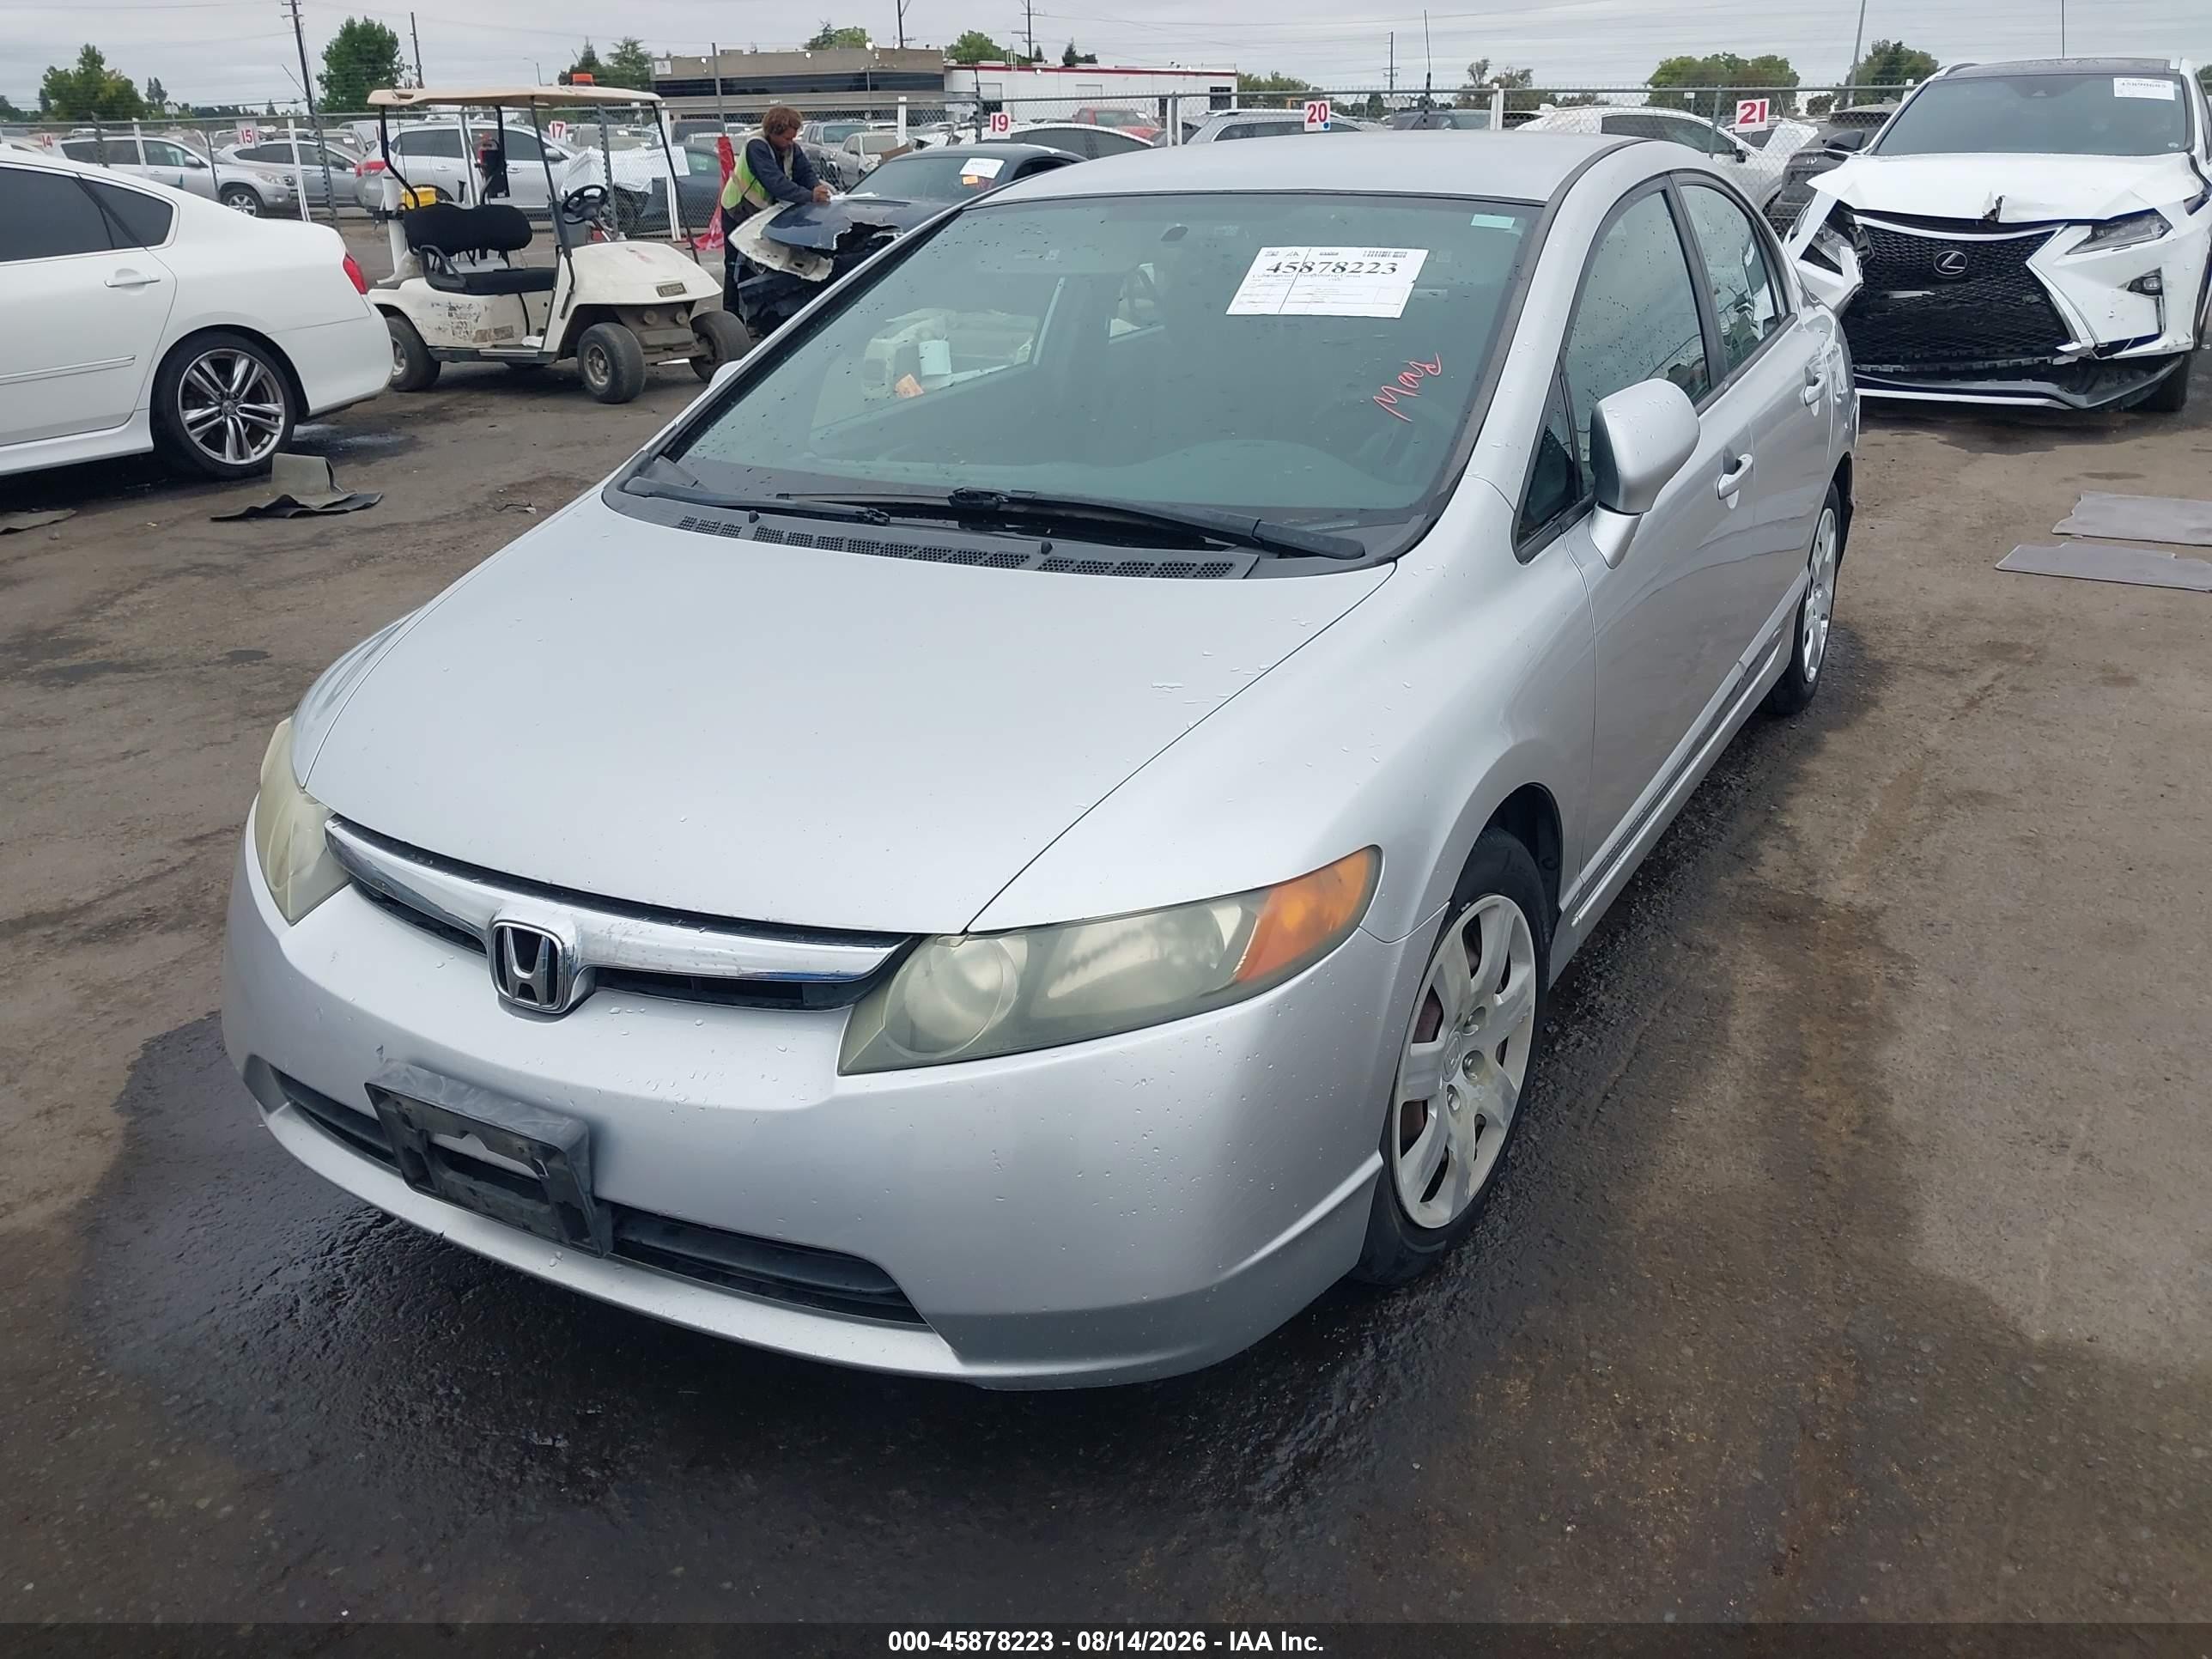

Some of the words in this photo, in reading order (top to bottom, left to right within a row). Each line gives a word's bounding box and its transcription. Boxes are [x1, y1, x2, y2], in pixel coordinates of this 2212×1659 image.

[1307, 102, 1328, 124] 20
[1739, 101, 1766, 125] 21
[552, 123, 564, 138] 17
[992, 114, 1009, 132] 19
[41, 135, 53, 149] 14
[241, 129, 253, 144] 15
[1266, 260, 1398, 275] 45878223
